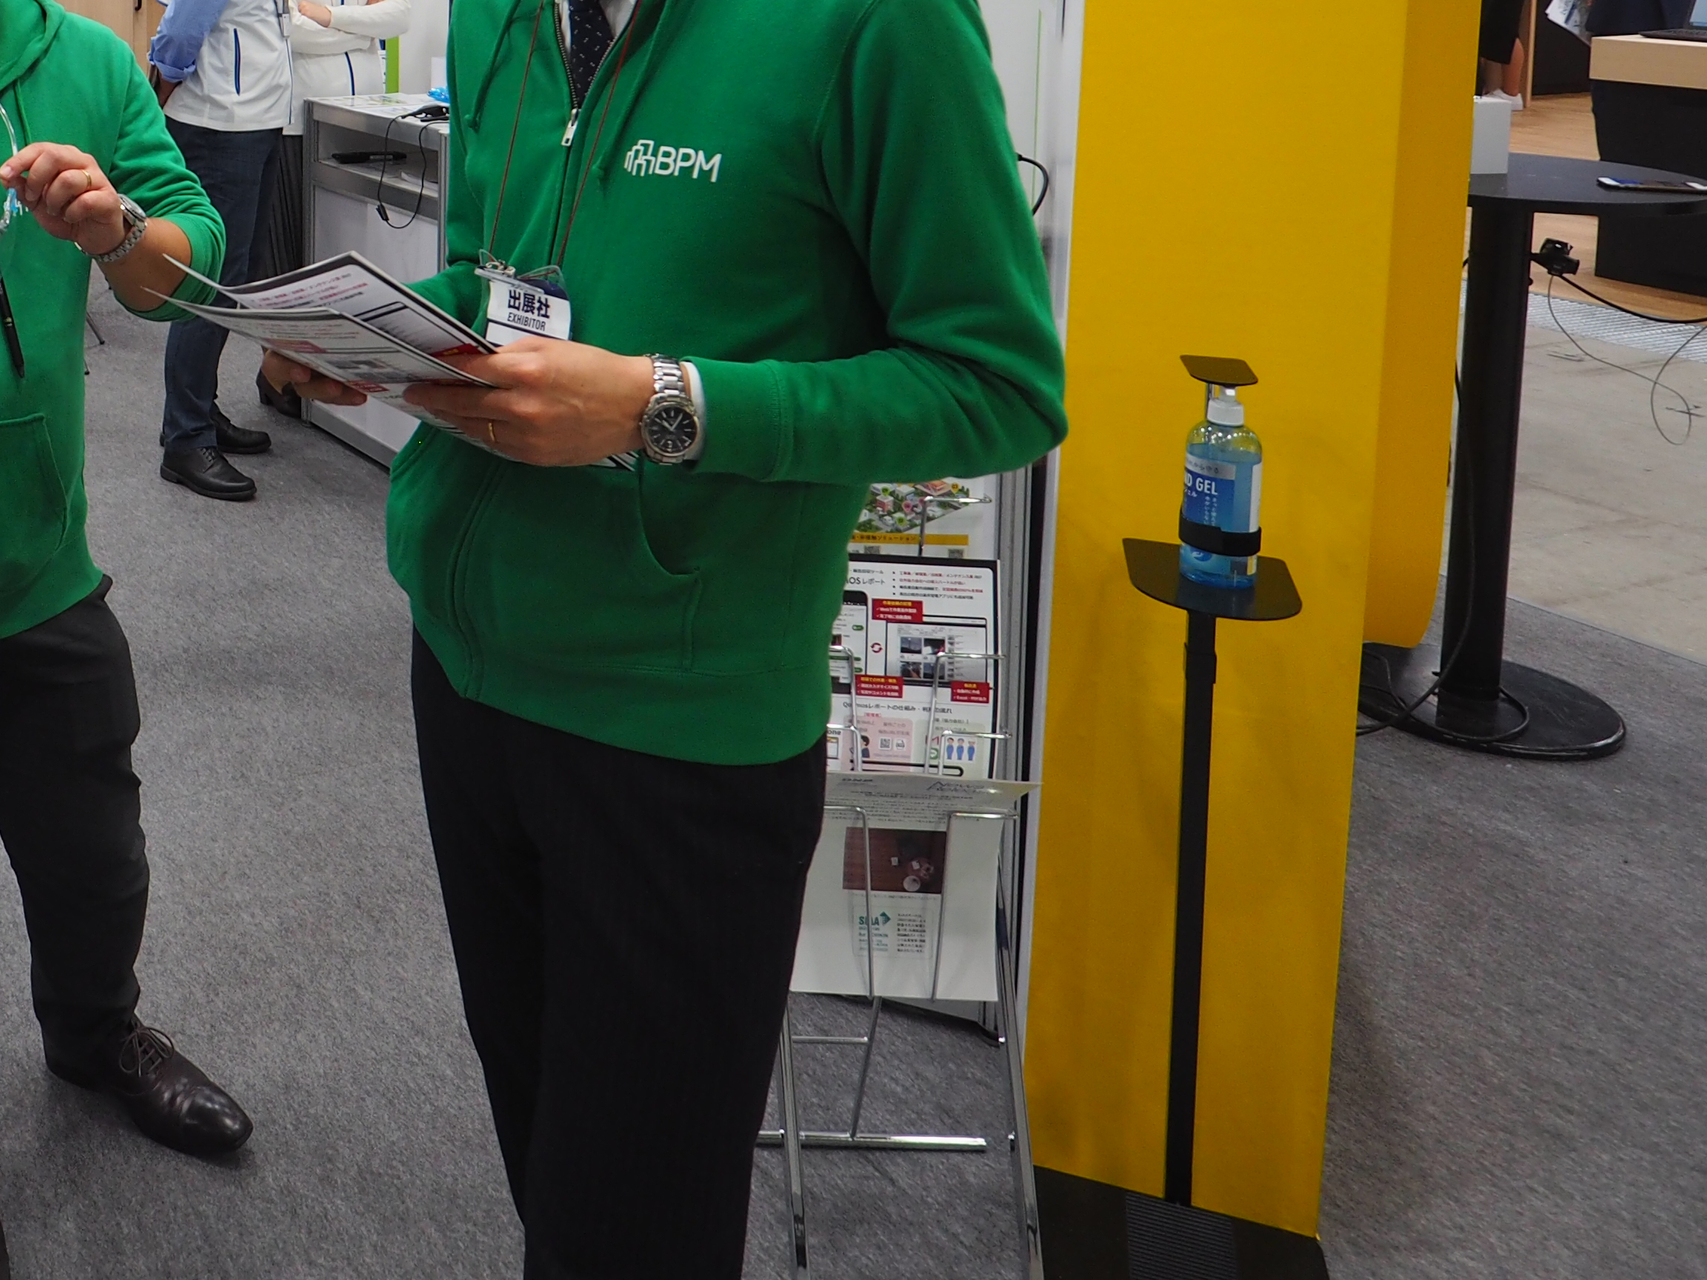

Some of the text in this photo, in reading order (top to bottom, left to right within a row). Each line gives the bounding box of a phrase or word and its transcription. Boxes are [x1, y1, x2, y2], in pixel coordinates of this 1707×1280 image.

[653, 145, 723, 183] BPM
[507, 288, 551, 320] 出展社
[506, 311, 547, 332] EXHIBITOR
[1195, 476, 1219, 496] GEL
